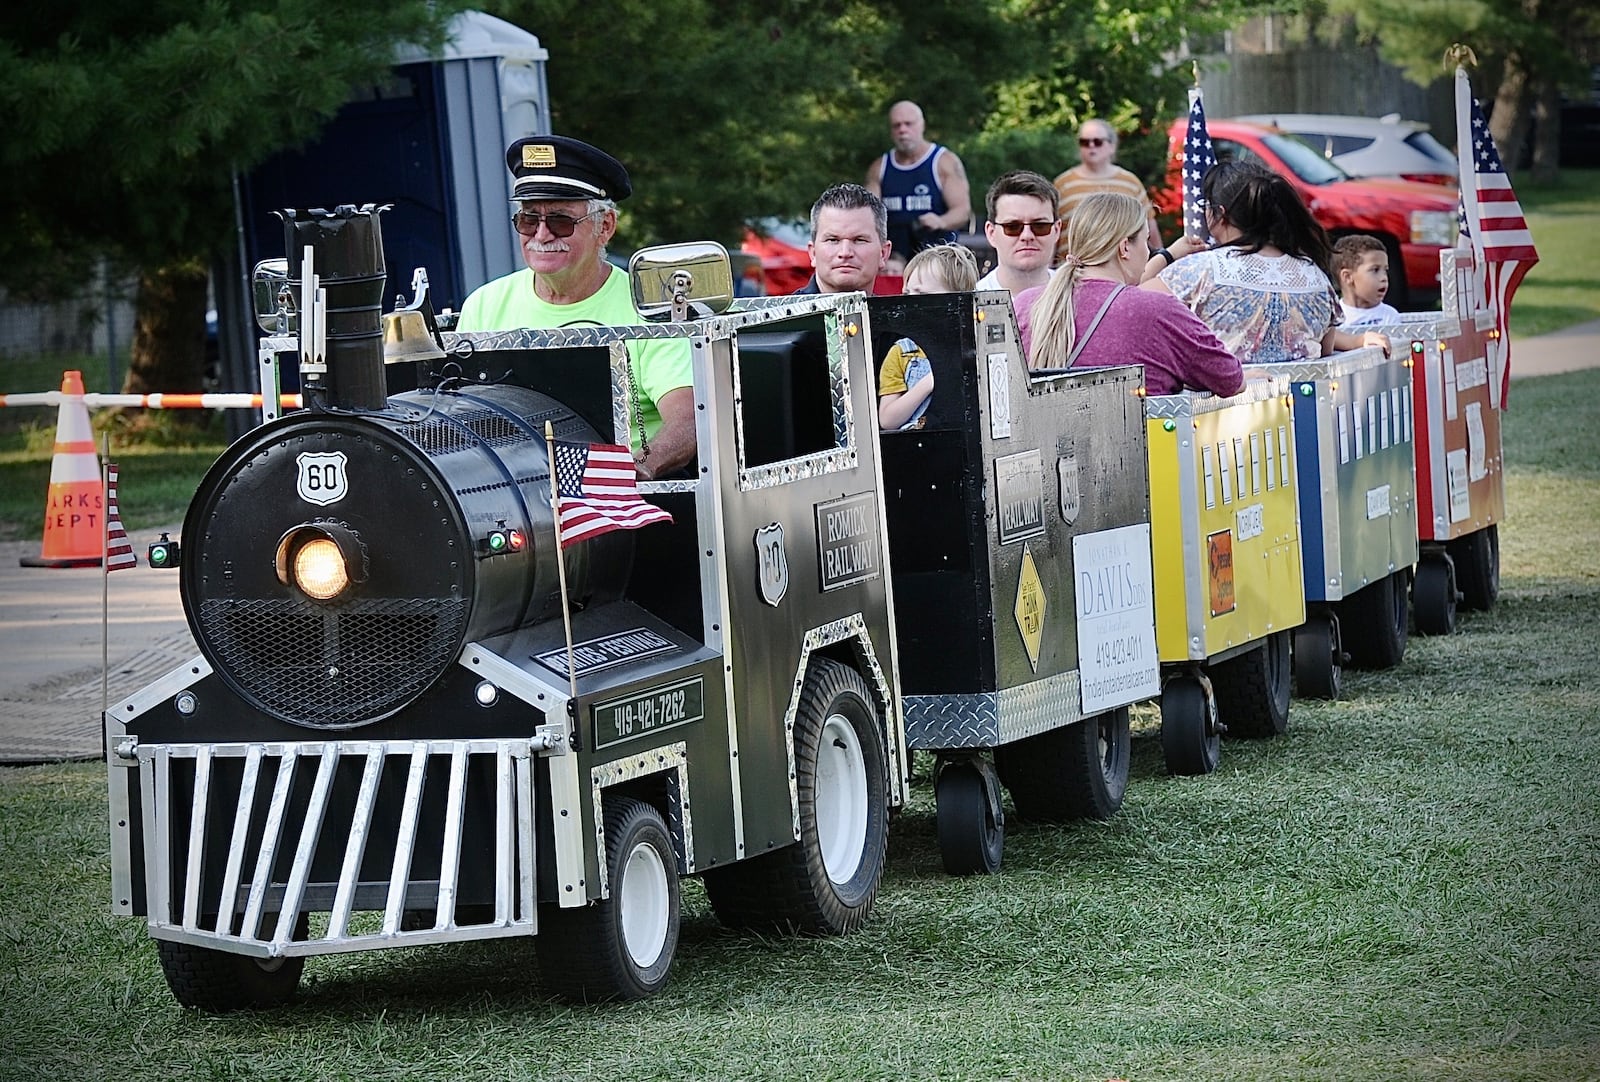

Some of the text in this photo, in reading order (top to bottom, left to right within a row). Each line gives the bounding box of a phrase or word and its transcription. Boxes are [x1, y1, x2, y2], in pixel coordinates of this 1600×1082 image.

[307, 464, 338, 490] 60
[826, 505, 868, 543] ROMICK
[1003, 495, 1040, 531] RAILWAY
[826, 540, 873, 579] RAILWAY
[1081, 561, 1133, 616] DAVIS
[544, 631, 669, 673] PARTIES FESTIVALS
[1096, 634, 1144, 669] 419.423.4011
[614, 690, 686, 737] 419-421-7262
